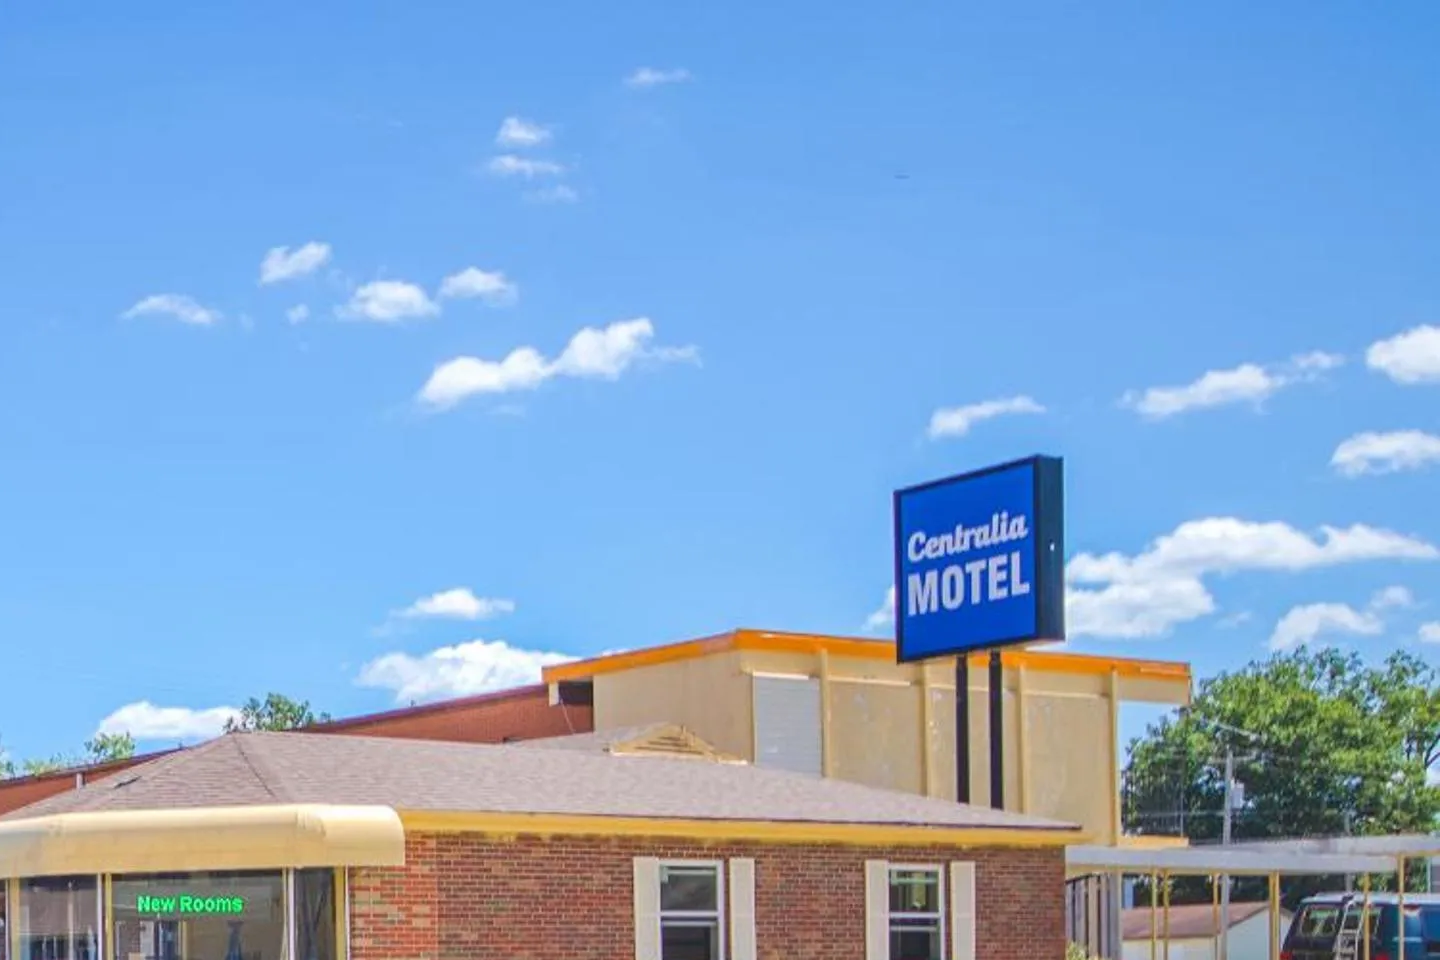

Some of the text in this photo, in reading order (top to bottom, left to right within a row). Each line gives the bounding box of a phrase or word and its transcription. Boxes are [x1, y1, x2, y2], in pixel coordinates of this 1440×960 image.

[907, 510, 1029, 562] Centralia
[907, 551, 1031, 617] MOTEL
[137, 895, 244, 913] New Rooms
